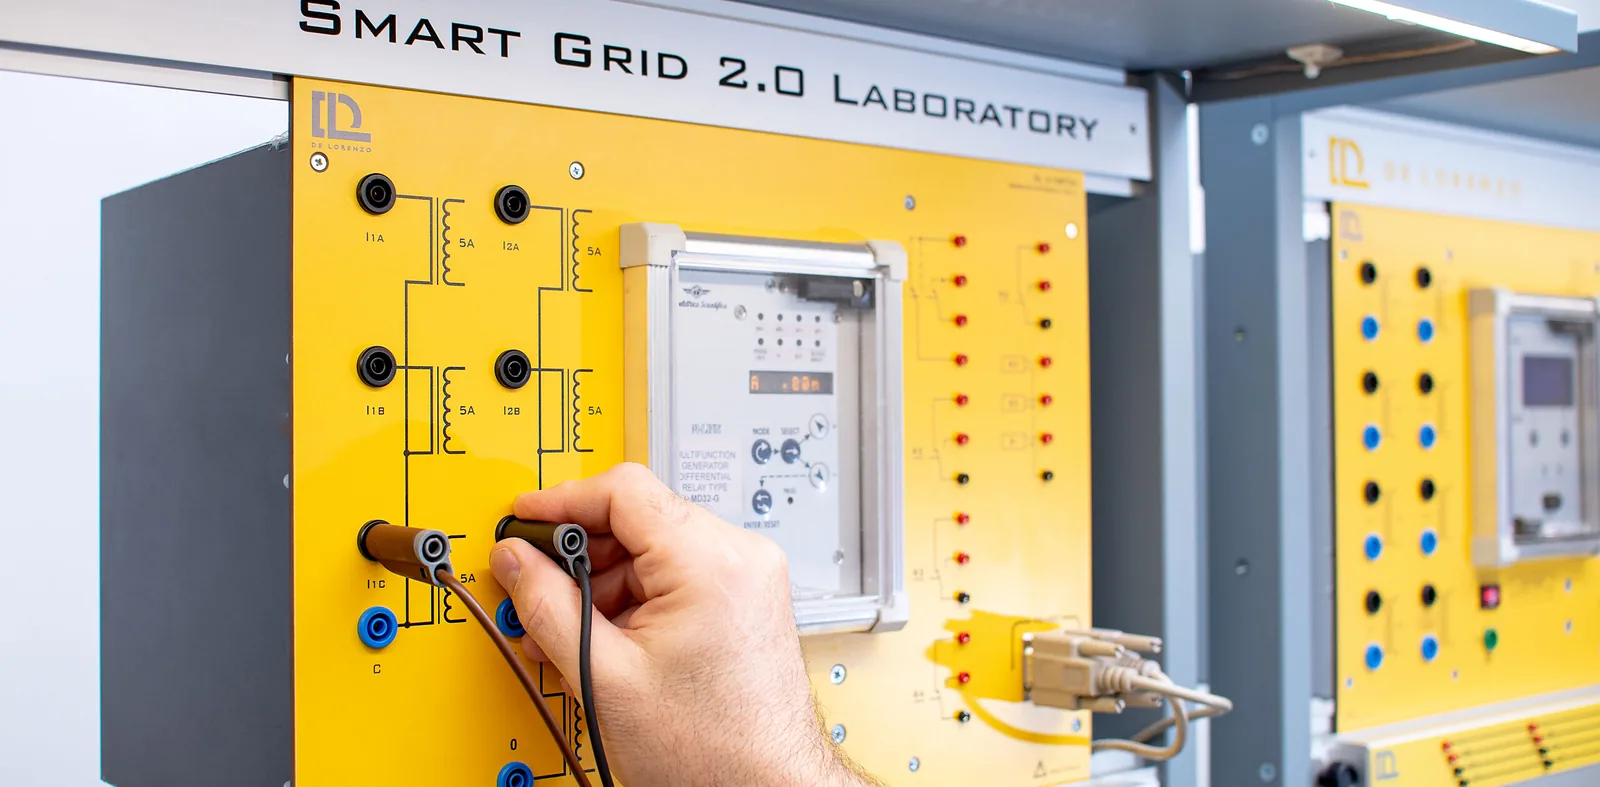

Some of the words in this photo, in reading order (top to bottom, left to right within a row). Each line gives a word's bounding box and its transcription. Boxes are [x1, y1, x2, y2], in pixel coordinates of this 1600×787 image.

[299, 0, 521, 58] SMART
[554, 31, 689, 80] GRID
[718, 56, 805, 98] 2.0
[833, 73, 1099, 142] LABORATORY
[328, 144, 372, 153] LORENZO
[459, 238, 475, 249] 5A
[587, 246, 602, 256] 5A
[751, 375, 760, 391] A
[366, 405, 385, 415] I1B
[460, 406, 476, 416] 5A
[503, 406, 521, 416] I2B
[588, 407, 602, 416] 5A
[681, 461, 729, 471] GENERATOR
[682, 483, 707, 493] RELAY
[709, 483, 728, 493] TYPE
[690, 494, 720, 503] MD32-G
[460, 573, 477, 584] 5A
